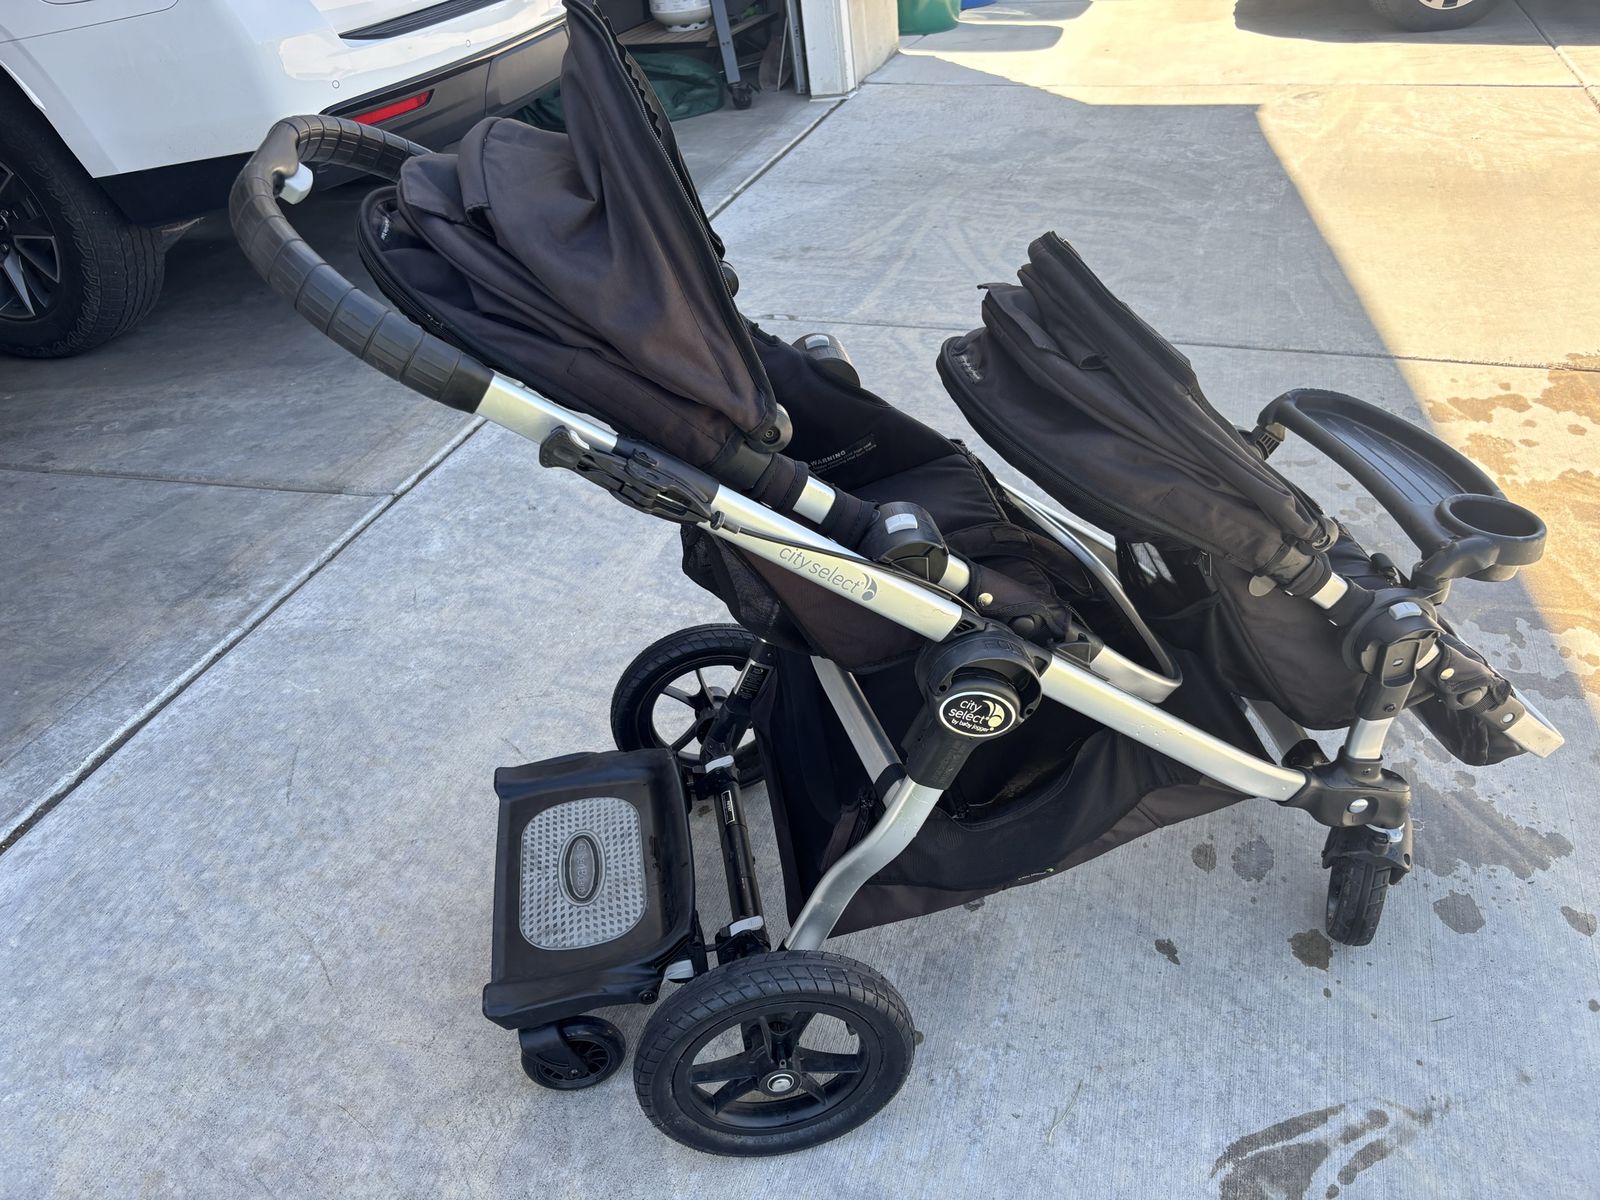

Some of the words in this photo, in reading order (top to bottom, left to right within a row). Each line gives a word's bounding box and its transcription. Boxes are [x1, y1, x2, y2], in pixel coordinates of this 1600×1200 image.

[779, 547, 812, 570] city
[808, 566, 861, 594] select
[960, 699, 982, 713] city
[948, 708, 985, 724] select
[959, 720, 972, 728] baby
[972, 724, 989, 732] jogger
